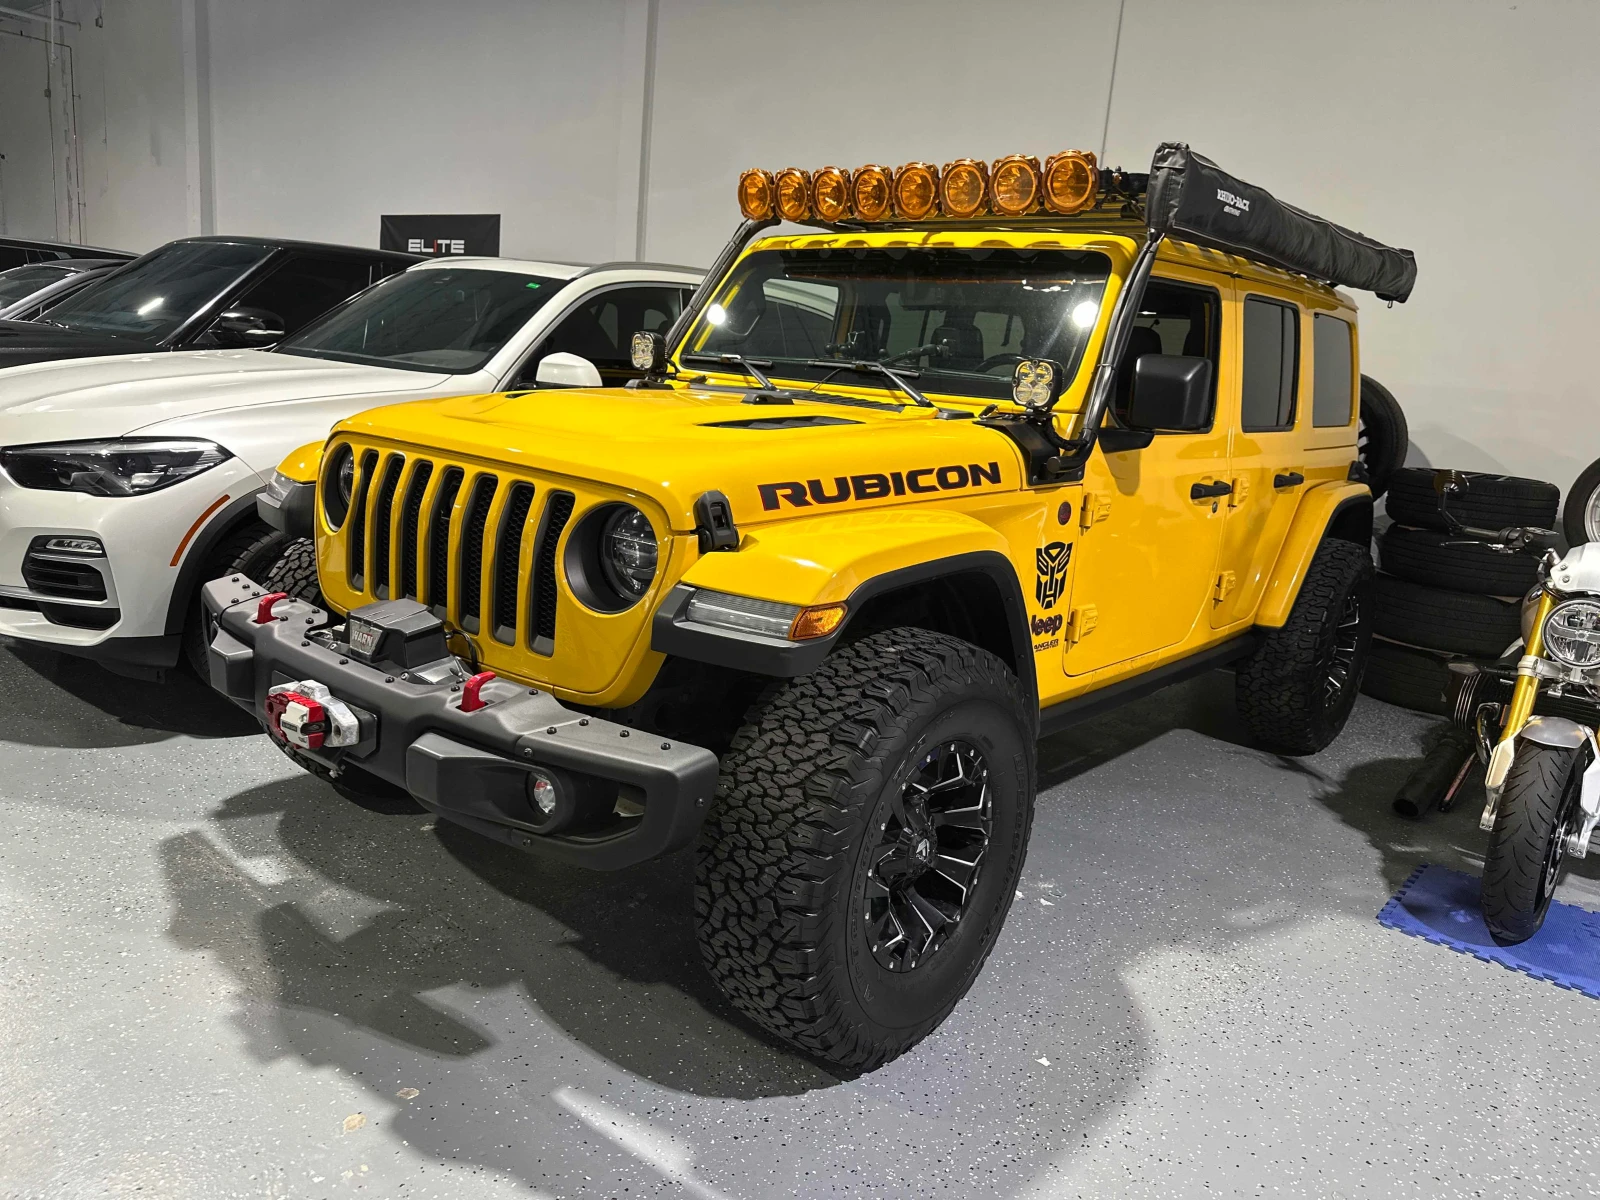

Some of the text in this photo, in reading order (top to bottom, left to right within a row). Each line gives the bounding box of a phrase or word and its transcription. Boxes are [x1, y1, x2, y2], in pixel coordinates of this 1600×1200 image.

[408, 239, 465, 253] ELITE
[757, 461, 1002, 511] RUBICON
[352, 629, 374, 646] WARN
